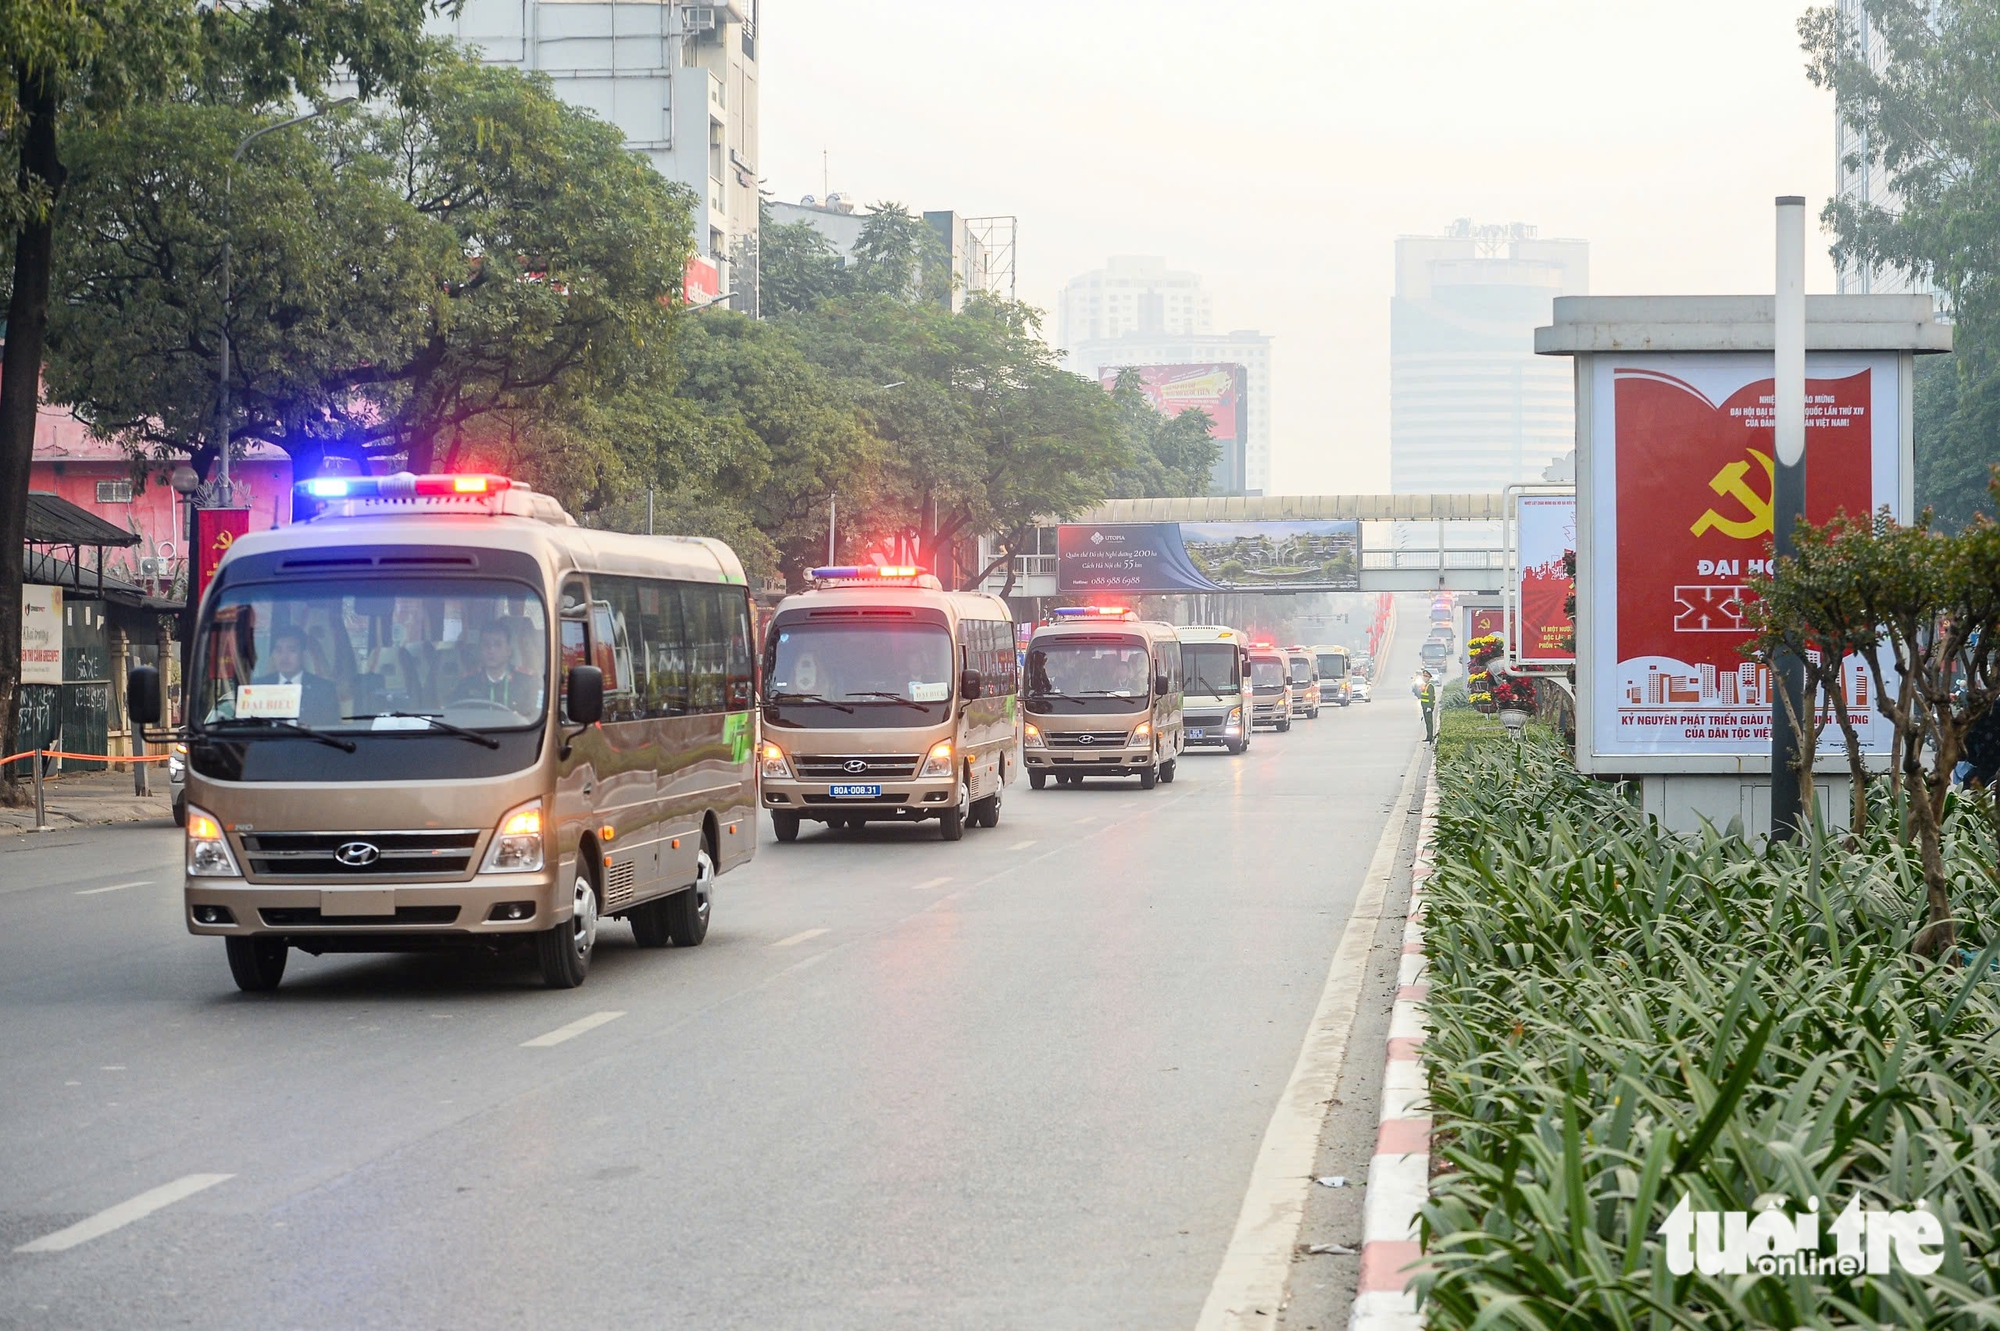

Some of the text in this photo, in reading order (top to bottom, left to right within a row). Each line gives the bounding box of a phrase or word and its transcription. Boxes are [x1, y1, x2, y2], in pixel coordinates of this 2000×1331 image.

[1759, 395, 1775, 405] NHIỆ
[1730, 408, 1742, 417] ĐẠI
[1743, 406, 1755, 417] HỘI
[1756, 408, 1768, 417] ĐẠI
[1839, 405, 1852, 415] THỨ
[1853, 407, 1864, 415] XIV
[1745, 416, 1759, 427] CỦA
[1760, 416, 1775, 427] ĐẢN
[1805, 415, 1814, 426] ẢN
[1816, 418, 1830, 428] VIỆT
[1124, 559, 1134, 570] 55
[1697, 559, 1739, 580] ĐẠI
[1106, 577, 1120, 586] 988
[1122, 576, 1140, 586] 6988
[1622, 712, 1635, 725] KỶ
[1637, 714, 1677, 725] NGUYÊN
[1680, 714, 1706, 725] PHÁT
[1708, 712, 1738, 725] TRIỂN
[1740, 713, 1764, 725] GIÀU
[1685, 726, 1705, 738] CỦA
[1708, 727, 1729, 738] DÂN
[1731, 727, 1751, 740] TỘC
[834, 786, 877, 794] 80A-008.31
